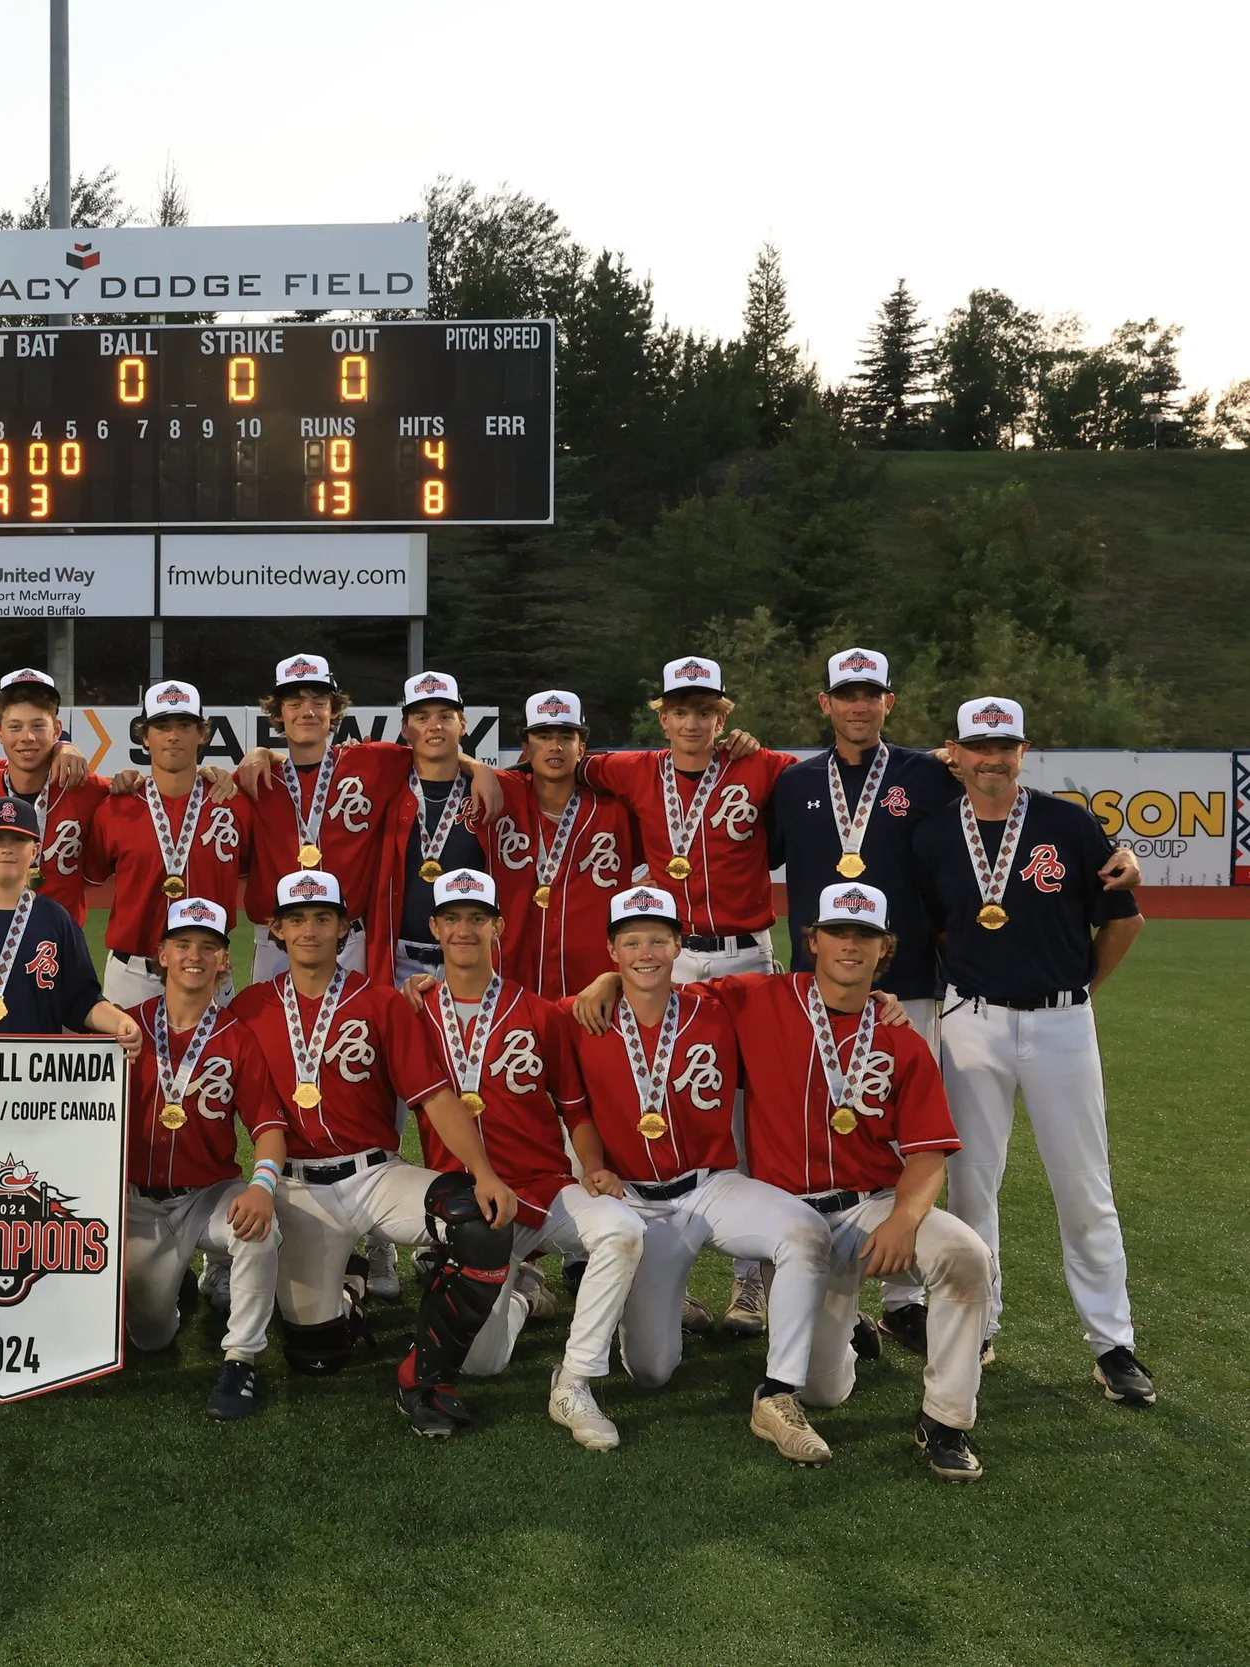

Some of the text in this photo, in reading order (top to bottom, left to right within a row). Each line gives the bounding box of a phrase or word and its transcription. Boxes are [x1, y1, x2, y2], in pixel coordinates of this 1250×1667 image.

[100, 274, 261, 299] DODGE
[284, 272, 414, 296] FIELD
[16, 333, 59, 358] BAT
[100, 332, 158, 356] BALL
[200, 330, 284, 355] STRIKE
[331, 328, 380, 353] OUT
[445, 326, 541, 351] PITCH SPEED
[119, 358, 145, 403] 0
[229, 357, 255, 402] 0
[341, 355, 367, 400] 0
[31, 420, 43, 440] 4
[65, 420, 78, 440] 5
[97, 419, 109, 440] 6
[137, 419, 149, 439] 7
[169, 419, 181, 439] 8
[202, 418, 214, 439] 9
[236, 418, 262, 438] 10
[300, 416, 356, 437] RUNS
[399, 416, 445, 436] HITS
[485, 415, 526, 436] ERR
[29, 442, 48, 475] 0
[61, 442, 80, 475] 0
[330, 439, 351, 473] 0
[424, 440, 445, 471] 4
[30, 483, 49, 518] 3
[317, 480, 351, 515] 13
[423, 480, 445, 515] 8
[55, 567, 95, 587] Way
[167, 565, 406, 590] fmwbunitedway.com
[19, 590, 81, 604] McMurray
[13, 606, 43, 616] Wood
[47, 605, 86, 616] Buffalo
[29, 1053, 116, 1082] CANADA
[0, 1101, 8, 1121] /
[11, 1101, 57, 1121] COUPE
[60, 1102, 116, 1122] CANADA
